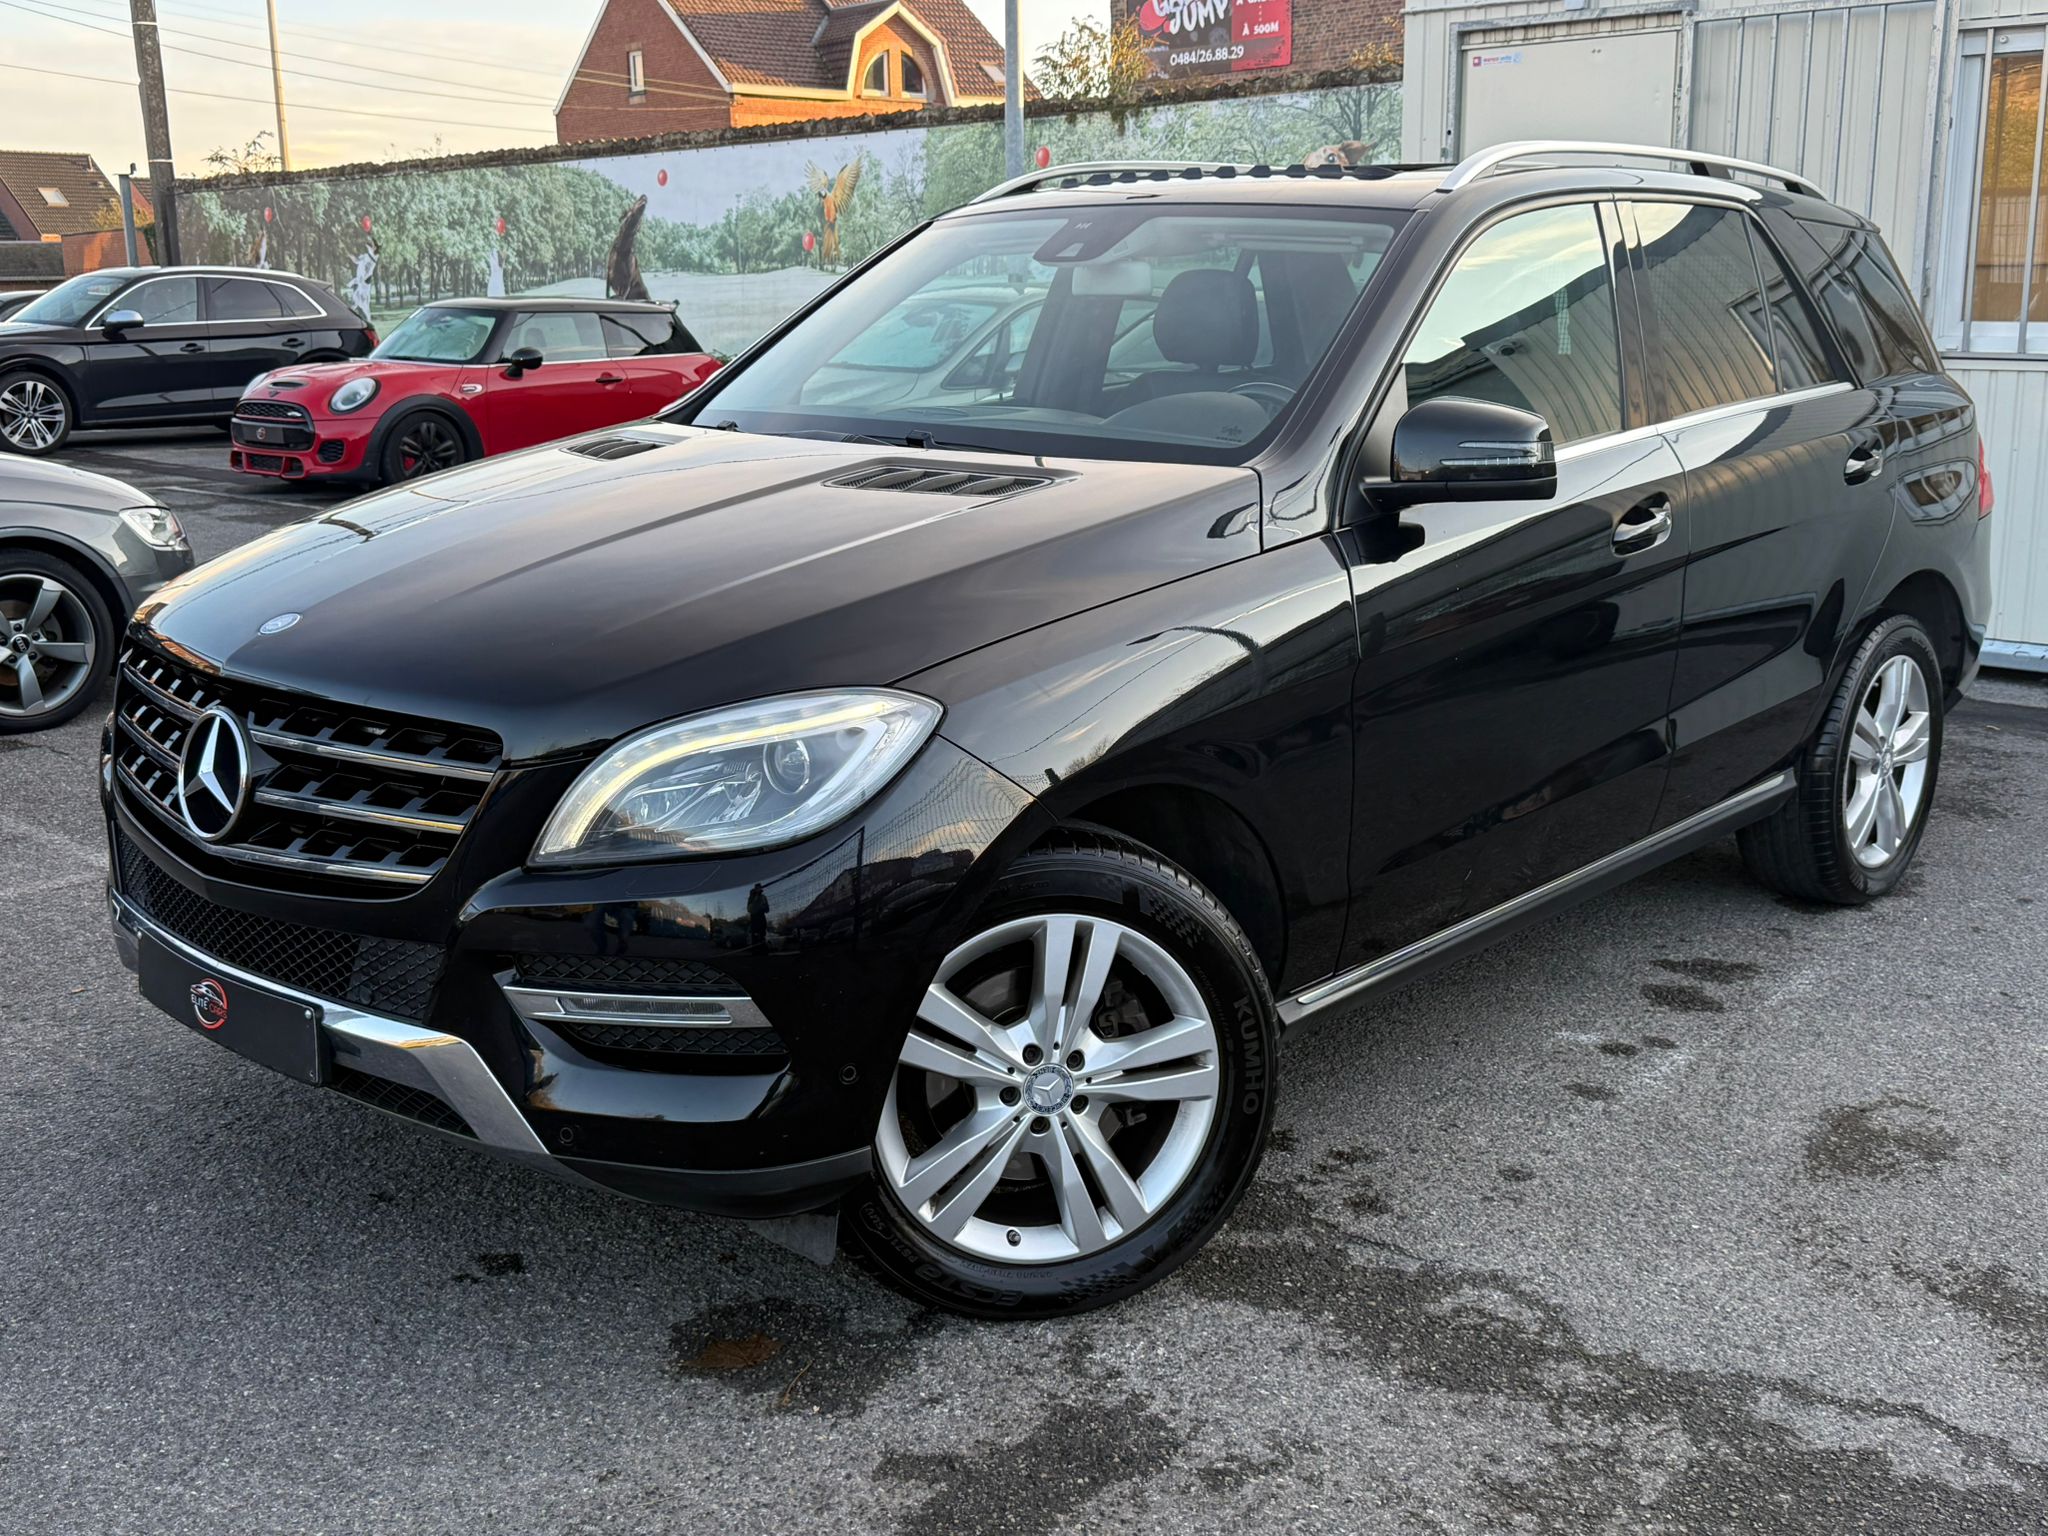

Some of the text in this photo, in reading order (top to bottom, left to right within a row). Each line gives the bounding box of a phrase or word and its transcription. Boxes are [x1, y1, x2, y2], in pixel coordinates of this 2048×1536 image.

[1253, 20, 1279, 35] 500M
[1169, 45, 1244, 66] 0484/26.88.29
[1234, 996, 1264, 1115] KUMHO
